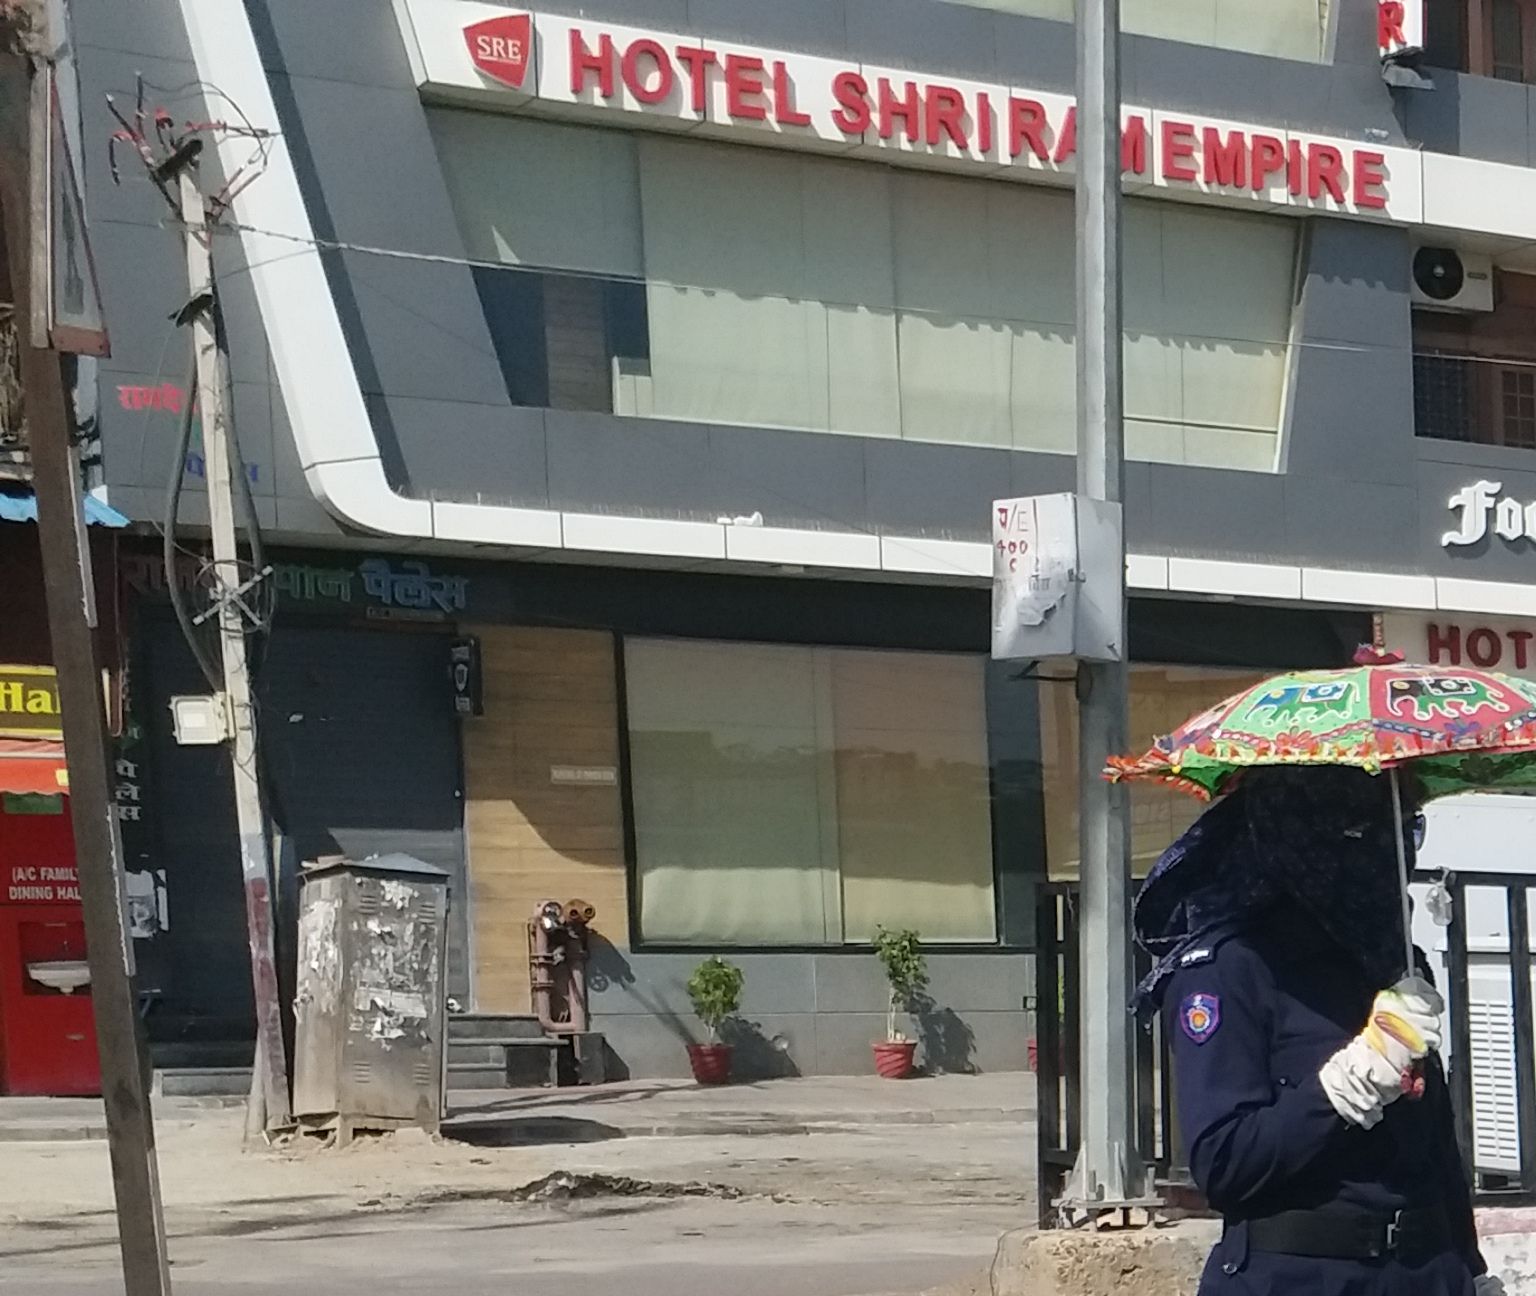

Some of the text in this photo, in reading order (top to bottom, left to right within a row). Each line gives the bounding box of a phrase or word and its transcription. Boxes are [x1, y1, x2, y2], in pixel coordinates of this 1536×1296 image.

[477, 35, 522, 60] SRE
[569, 28, 811, 127] HOTEL
[831, 71, 991, 153] SHRI
[1161, 120, 1388, 210] EMPIRE
[40, 867, 78, 881] FAMIL
[9, 886, 53, 901] DINING
